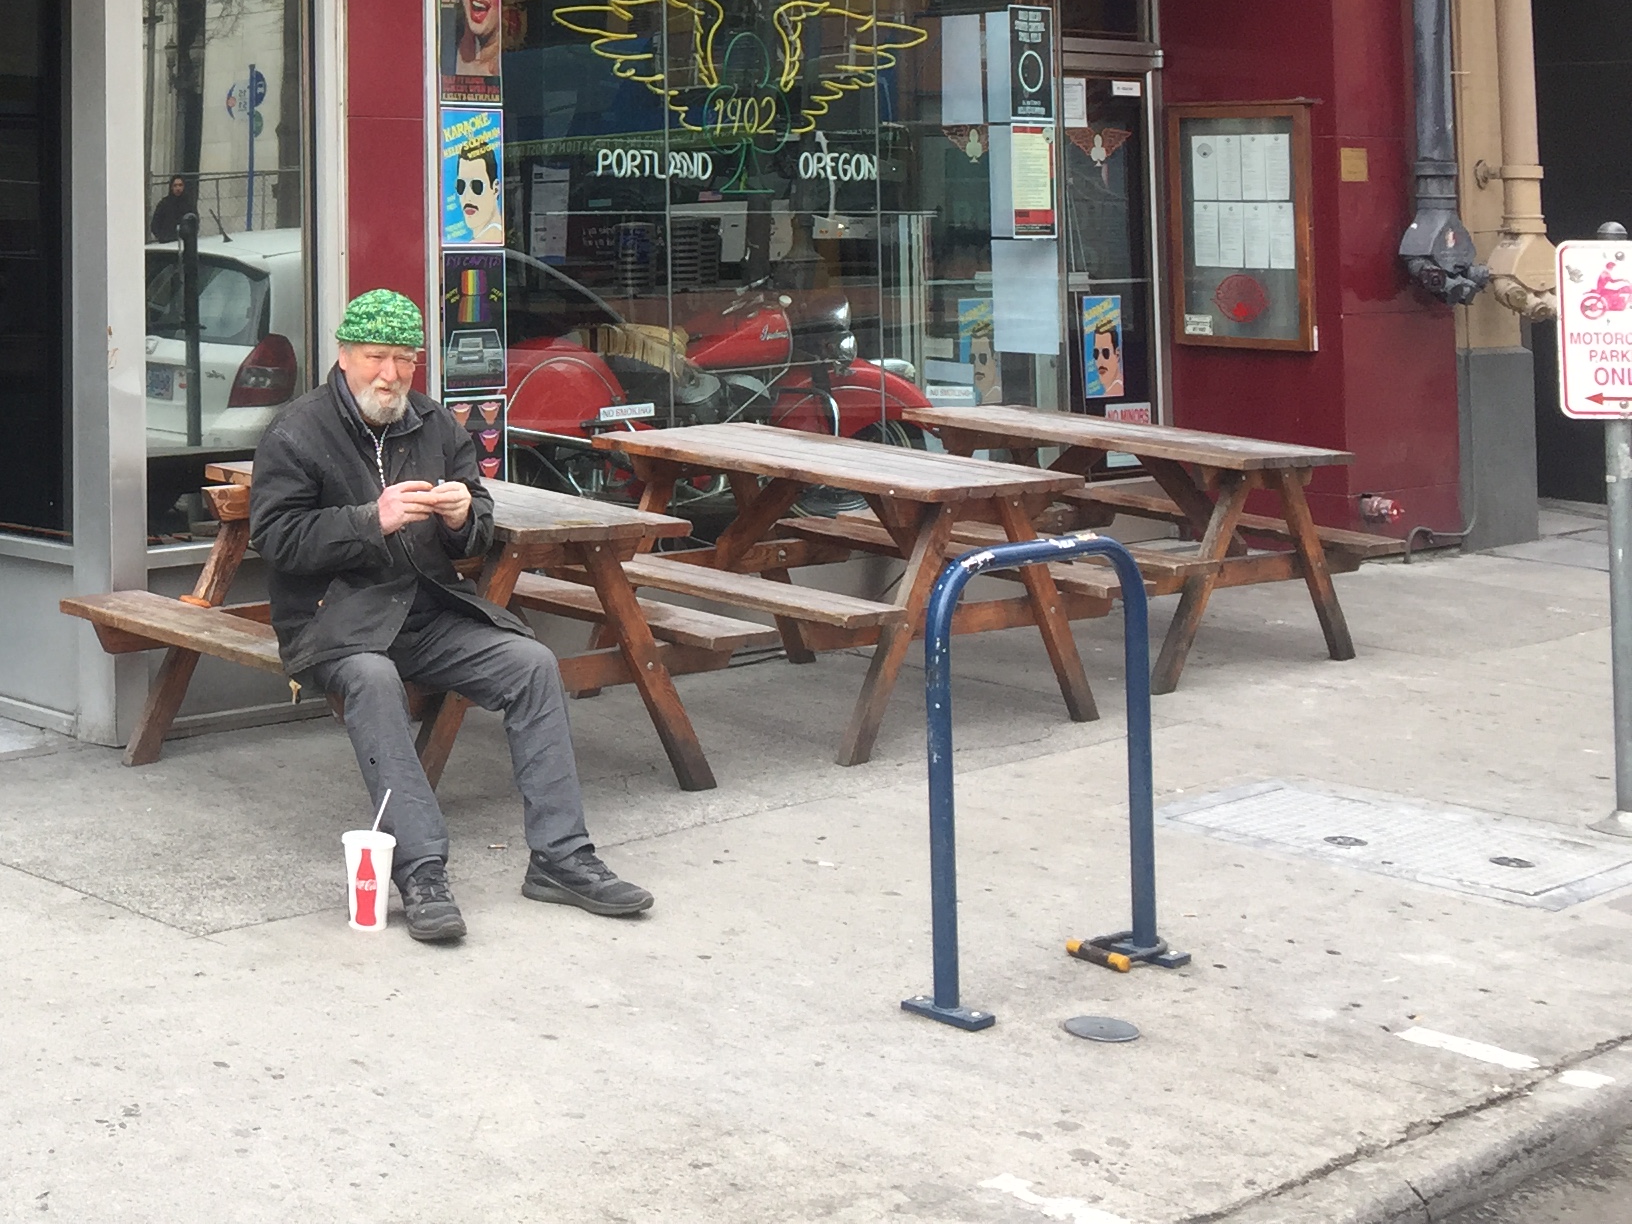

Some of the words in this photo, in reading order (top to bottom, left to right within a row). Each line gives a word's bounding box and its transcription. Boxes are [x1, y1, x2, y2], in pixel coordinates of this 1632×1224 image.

[443, 112, 492, 142] KARAOKE
[714, 96, 776, 137] 1902
[596, 149, 714, 180] PORTLAND
[798, 152, 878, 181] OREGON
[602, 408, 614, 418] NO
[615, 405, 652, 417] SMOKING
